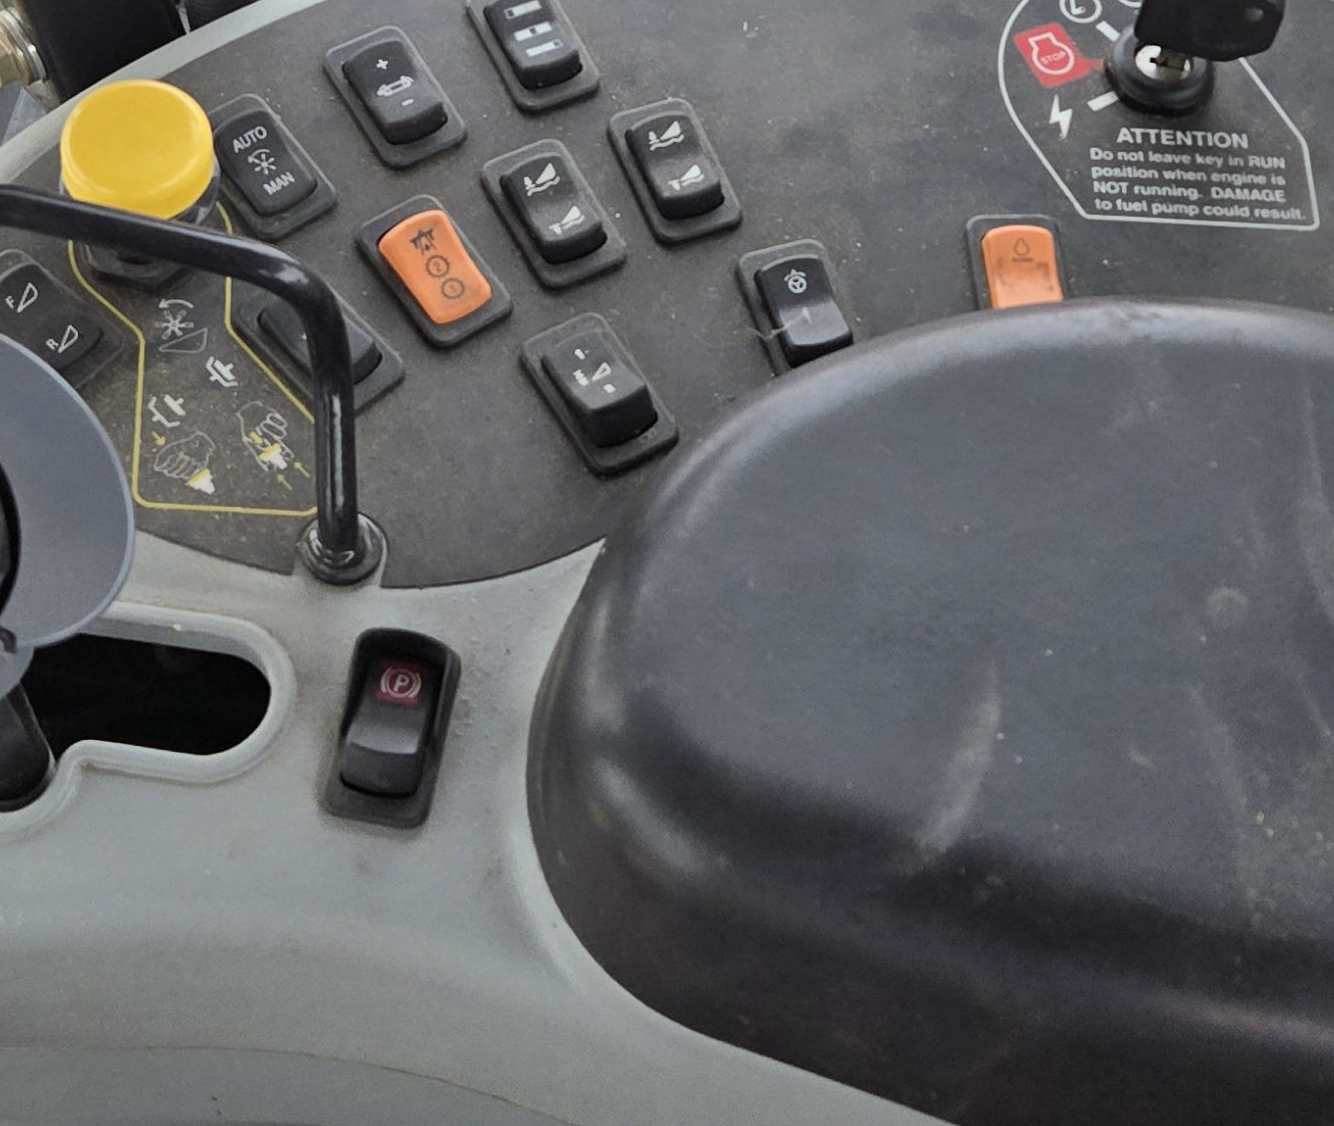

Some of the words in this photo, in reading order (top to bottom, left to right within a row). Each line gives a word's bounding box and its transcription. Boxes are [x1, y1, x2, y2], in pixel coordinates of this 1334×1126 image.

[1041, 51, 1066, 64] STOP
[233, 126, 267, 153] AUTO
[1117, 127, 1248, 149] ATTENTION
[1090, 147, 1113, 161] Do
[1117, 150, 1144, 163] not
[1149, 151, 1191, 164] leave
[1196, 153, 1223, 168] key
[1228, 154, 1244, 167] in
[1248, 155, 1286, 169] RUN
[263, 171, 295, 195] MAN
[1091, 165, 1158, 179] position
[1162, 168, 1207, 182] when
[1211, 171, 1267, 186] engine
[1271, 173, 1286, 185] is
[1093, 181, 1128, 194] NOT
[1133, 183, 1203, 201] running.
[1211, 187, 1286, 203] DAMAGE
[1094, 198, 1112, 210] to
[1116, 199, 1148, 212] fuel
[1152, 202, 1199, 217] pump
[1202, 204, 1250, 218] could
[1254, 206, 1306, 221] result.
[5, 295, 14, 309] F
[46, 338, 59, 351] R
[393, 674, 409, 692] P
